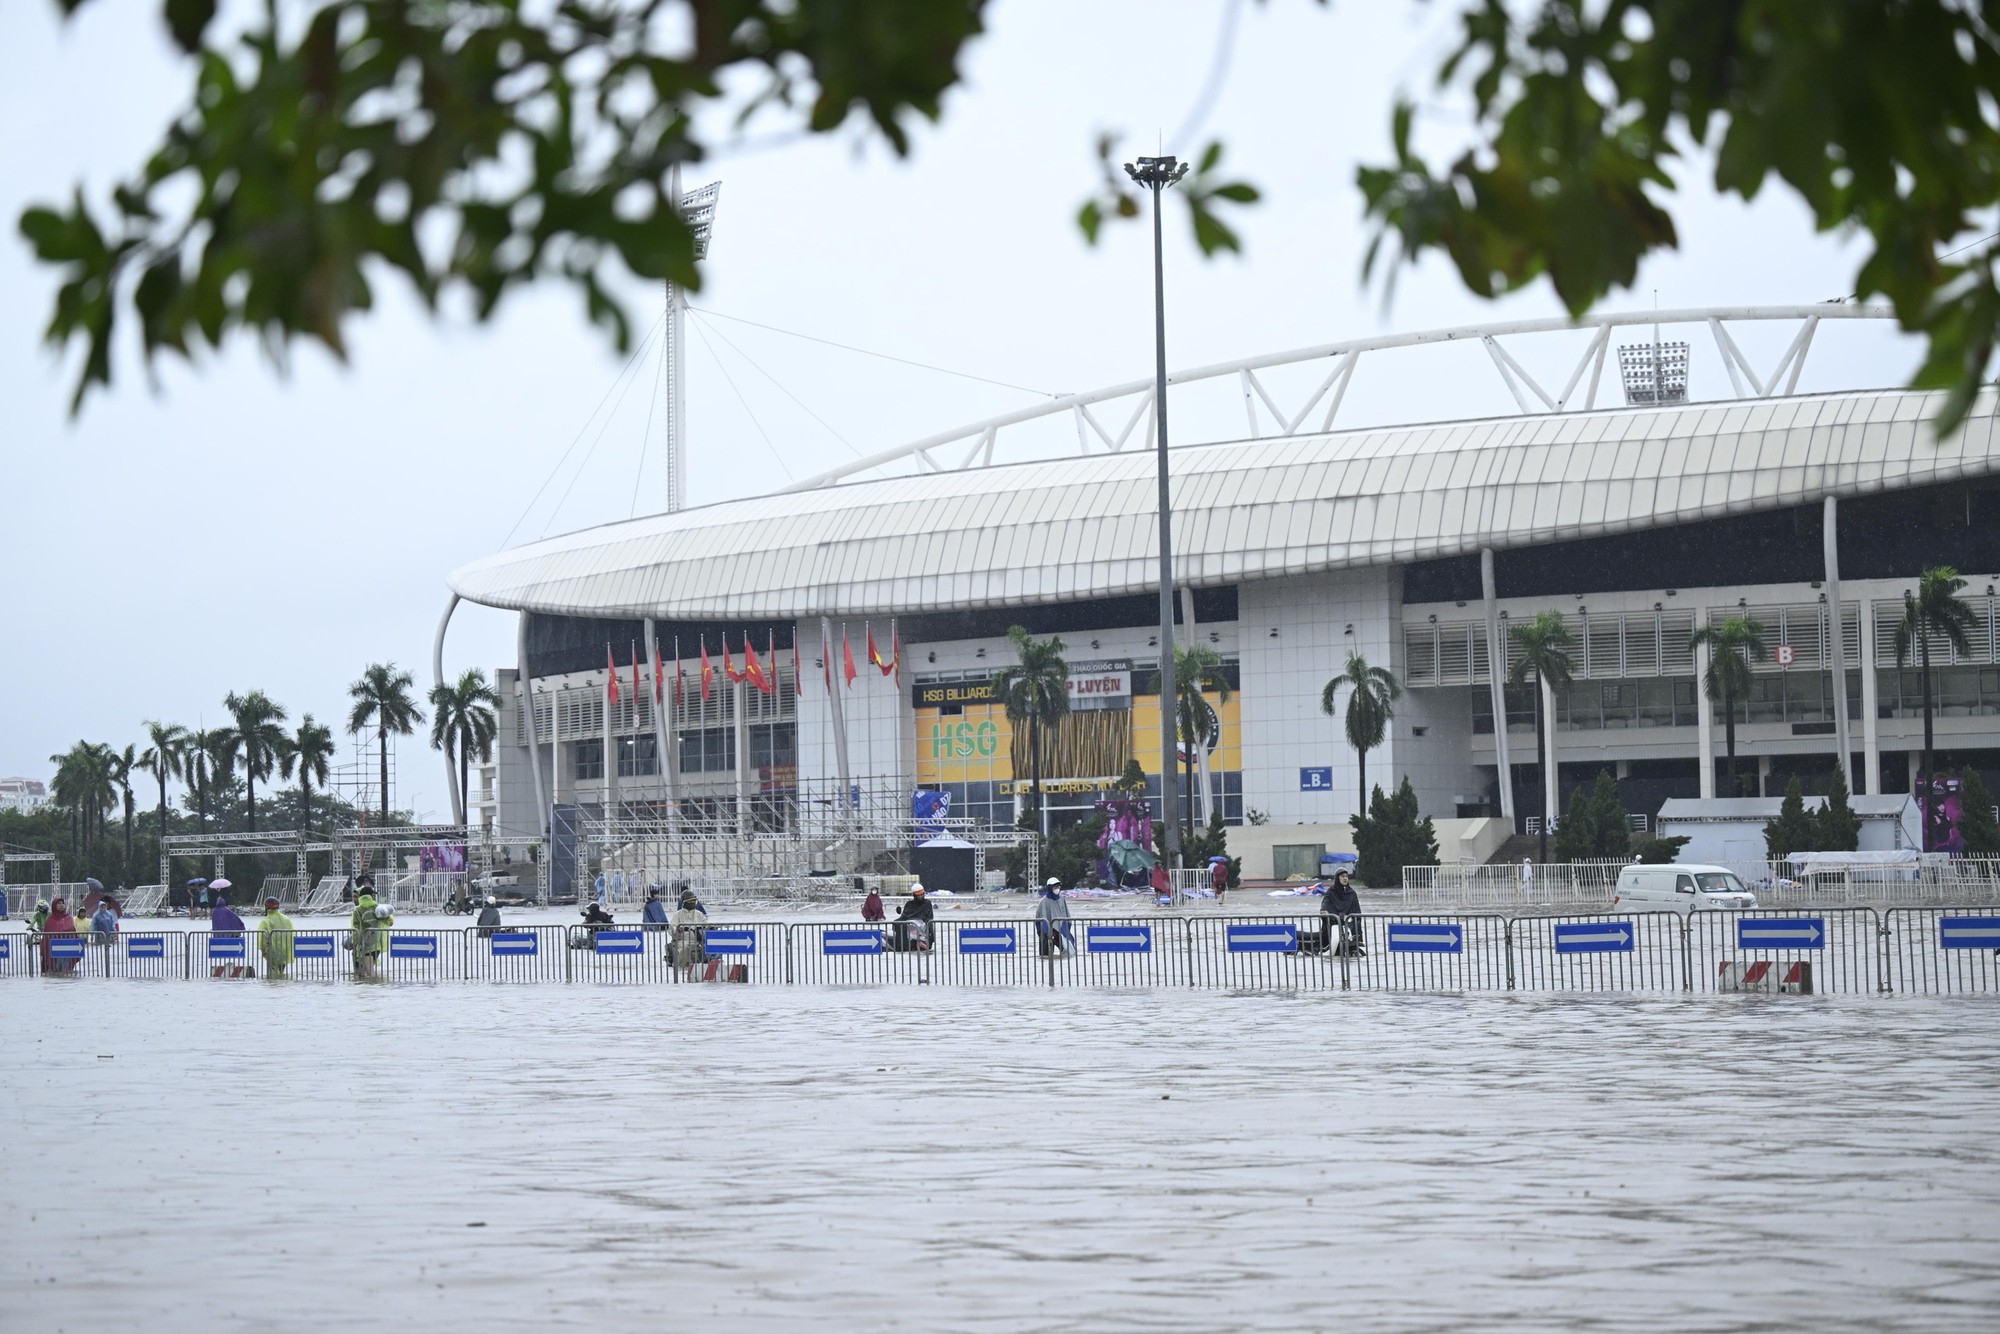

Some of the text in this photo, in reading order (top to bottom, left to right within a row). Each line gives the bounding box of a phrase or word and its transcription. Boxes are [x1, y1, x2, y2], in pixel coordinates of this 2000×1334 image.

[1779, 647, 1792, 663] B
[1092, 661, 1113, 671] QUỐC
[1114, 662, 1127, 670] GIA
[1077, 676, 1121, 694] LUYỆN
[923, 689, 944, 702] HSG
[932, 720, 998, 759] HSG
[1311, 773, 1321, 787] B
[999, 782, 1030, 795] CLUB
